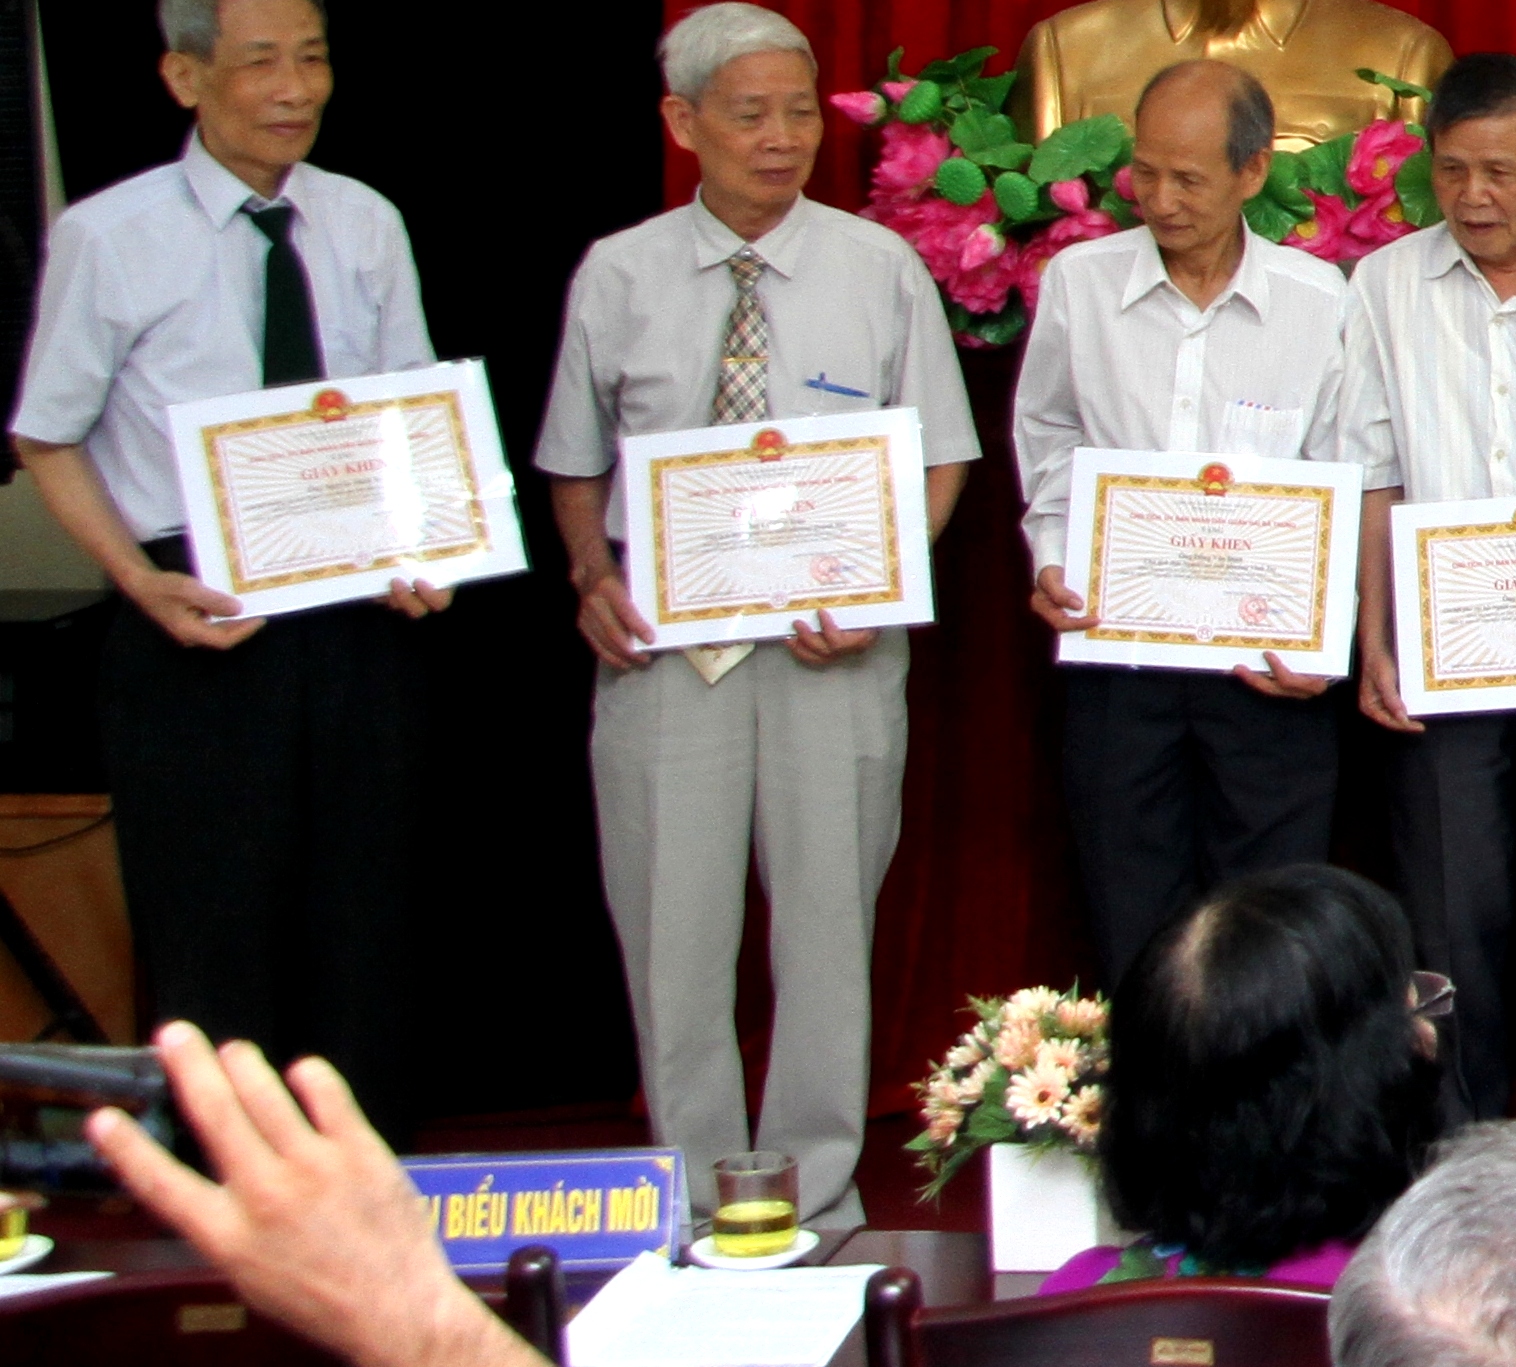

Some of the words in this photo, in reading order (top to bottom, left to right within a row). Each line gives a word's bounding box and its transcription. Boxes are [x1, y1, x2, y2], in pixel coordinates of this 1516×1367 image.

[1170, 533, 1205, 549] GIẤY
[1211, 536, 1253, 551] KHEN
[445, 1174, 508, 1239] BIỂU
[512, 1179, 602, 1235] KHÁCH
[608, 1175, 660, 1232] MỜI
